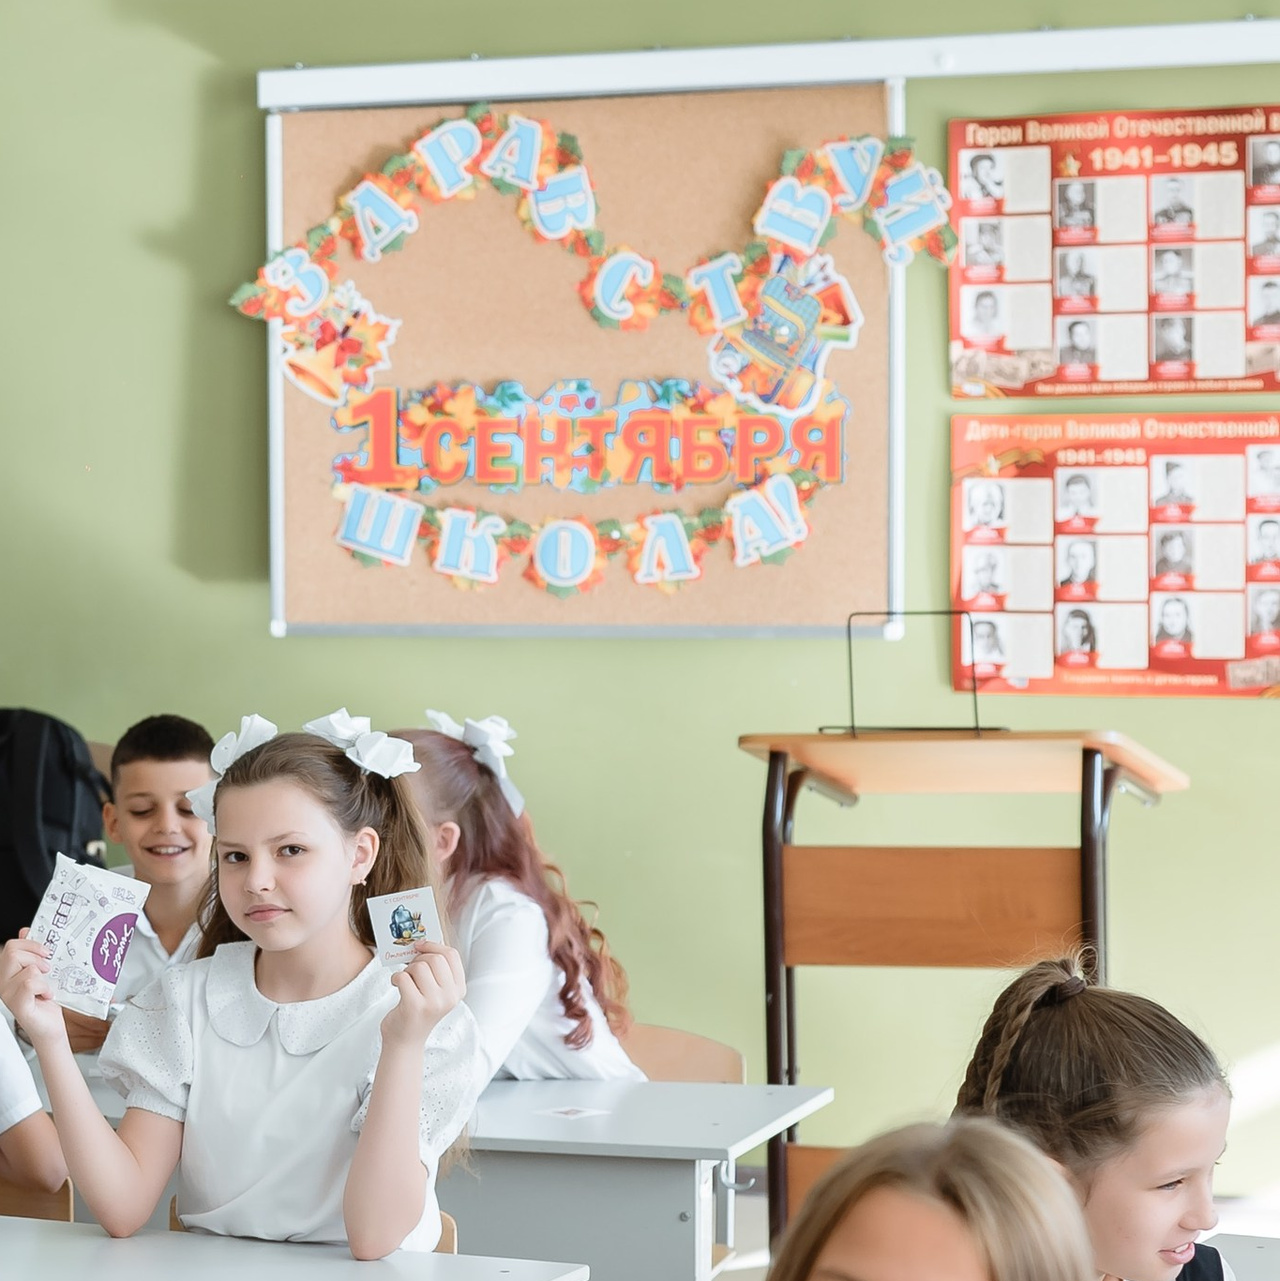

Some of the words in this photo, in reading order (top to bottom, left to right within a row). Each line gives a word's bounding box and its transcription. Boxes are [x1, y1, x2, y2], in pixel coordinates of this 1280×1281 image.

[965, 123, 1023, 147] Герои
[1025, 116, 1110, 143] Великой
[351, 388, 404, 484] 1
[421, 416, 843, 484] СЕНТЯБРЯ
[336, 474, 809, 587] ШКОЛА!
[100, 929, 118, 966] Cat
